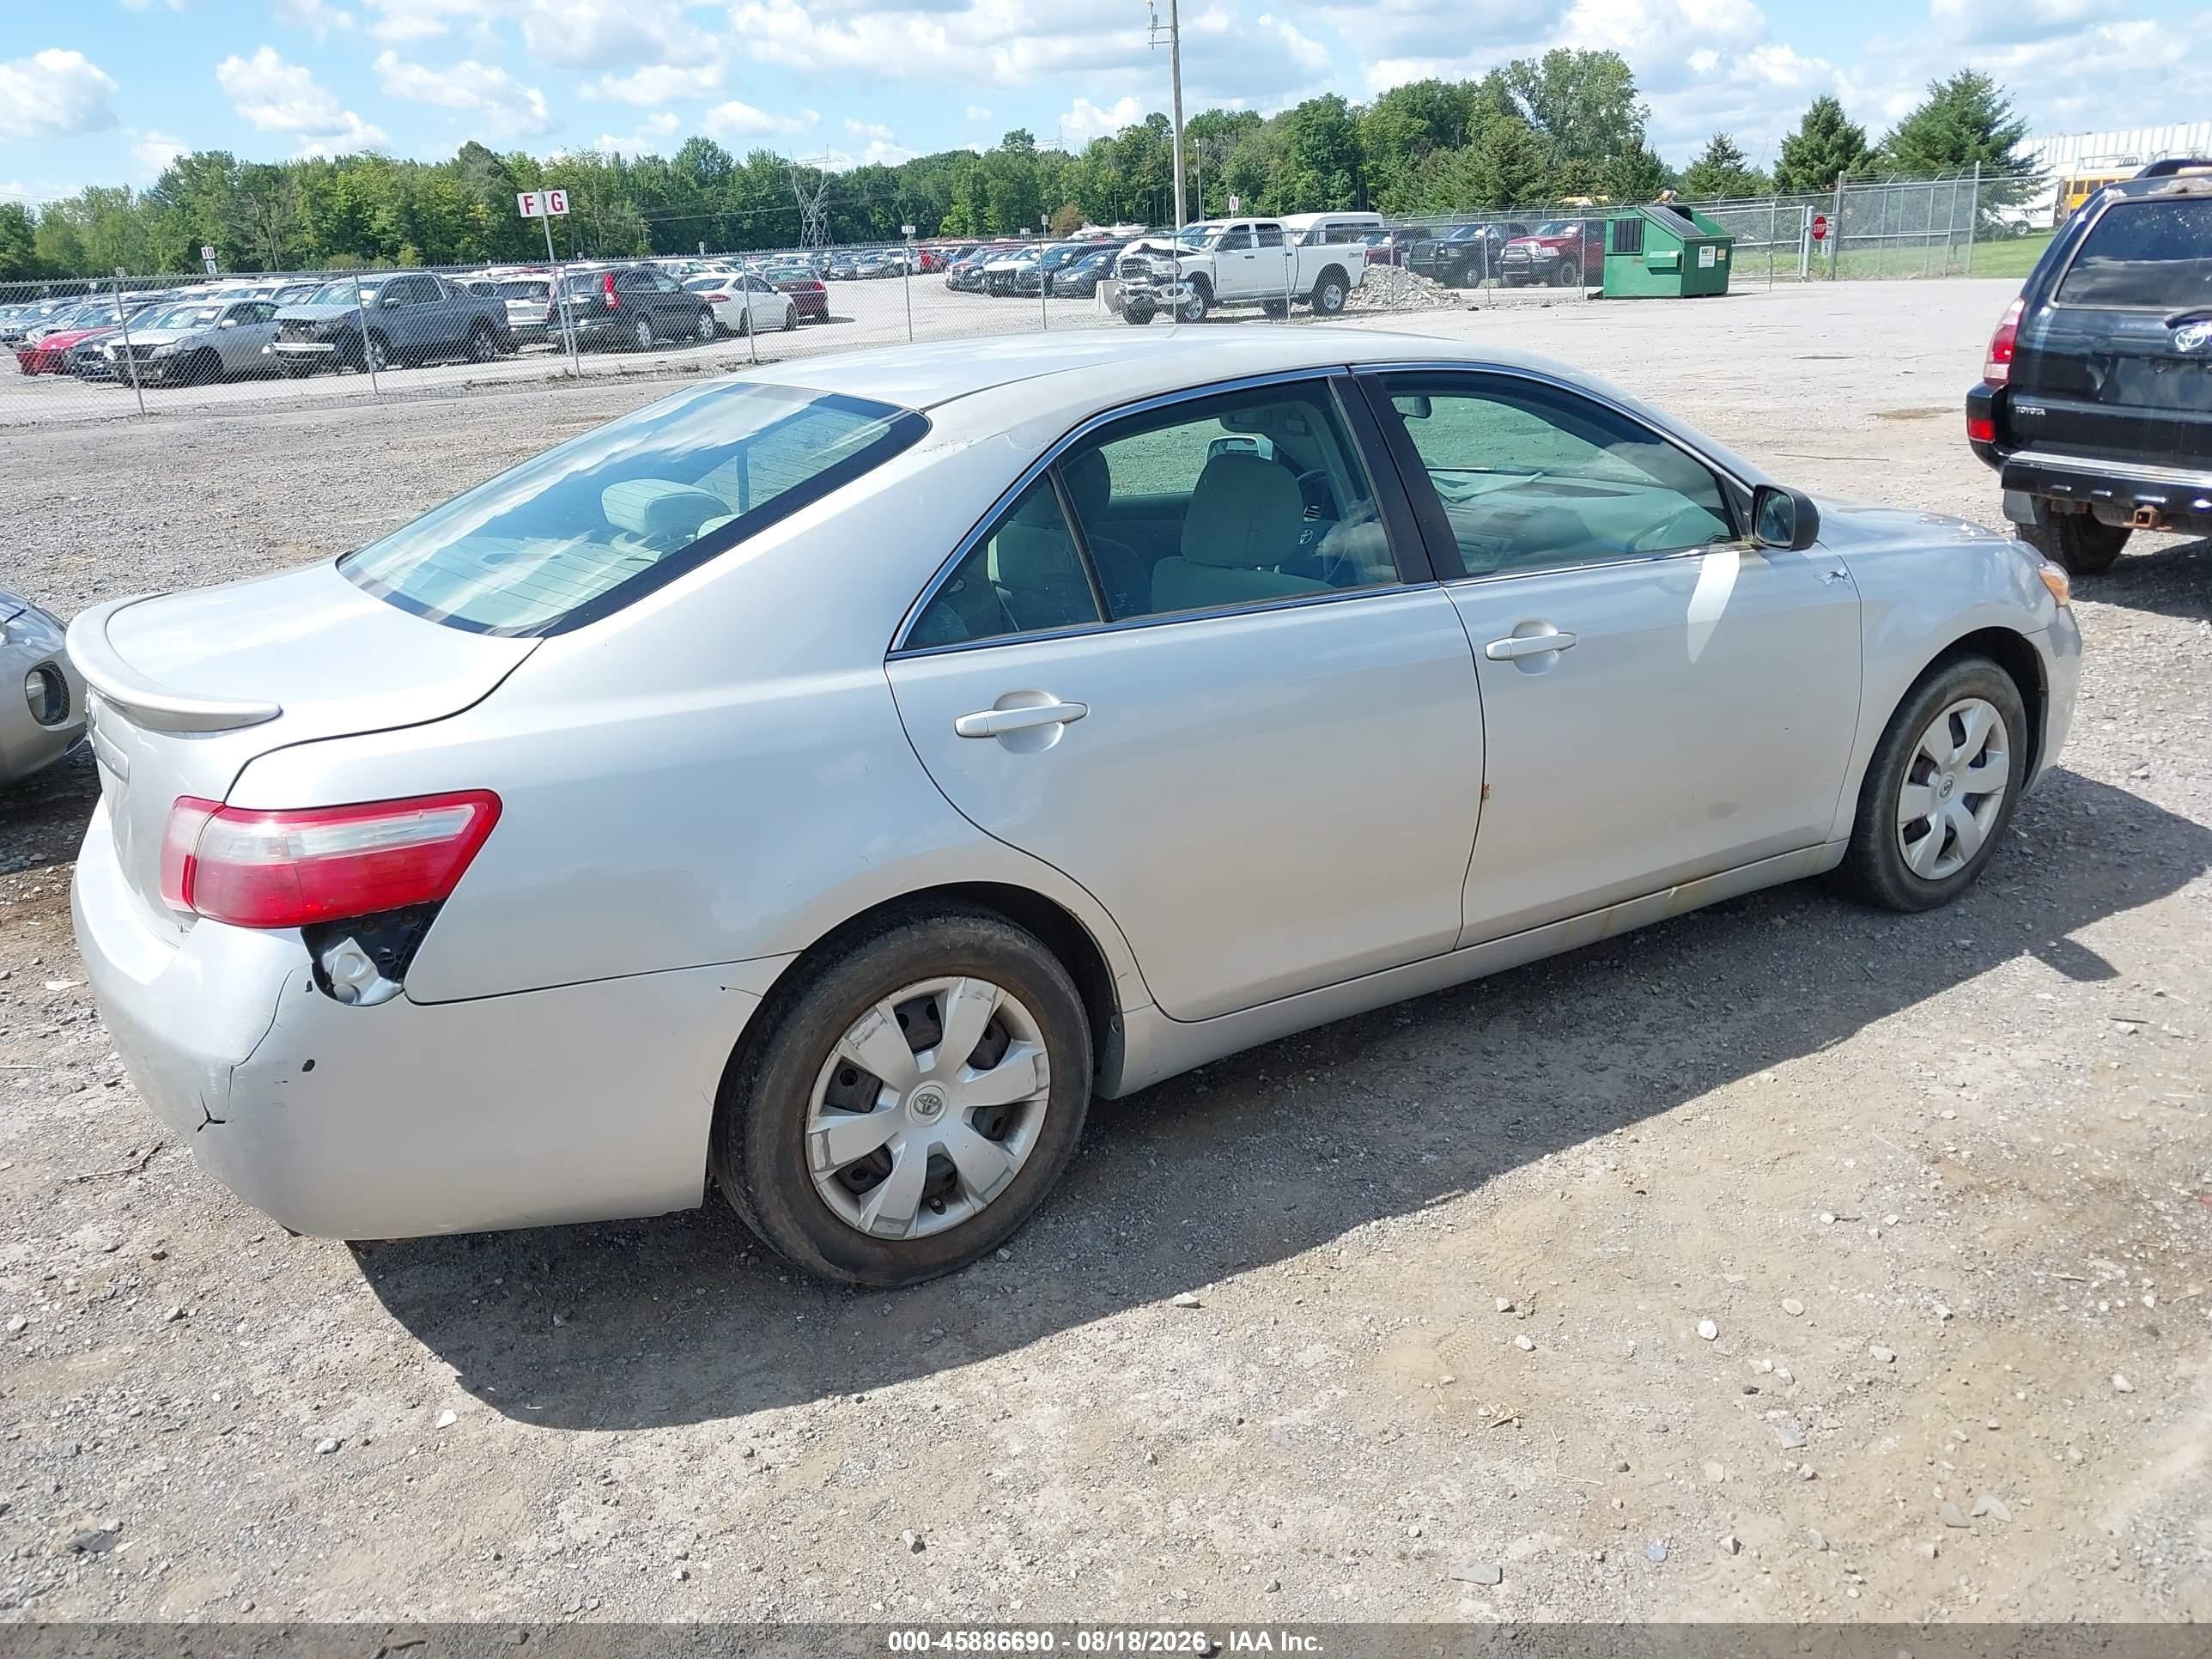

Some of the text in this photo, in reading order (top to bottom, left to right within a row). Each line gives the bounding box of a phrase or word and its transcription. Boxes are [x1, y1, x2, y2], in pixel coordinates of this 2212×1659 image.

[523, 195, 534, 215] F
[550, 192, 564, 212] G
[1231, 198, 1237, 209] N
[1813, 223, 1826, 234] STOP
[203, 248, 214, 258] 10
[2015, 406, 2045, 416] TOYOTA
